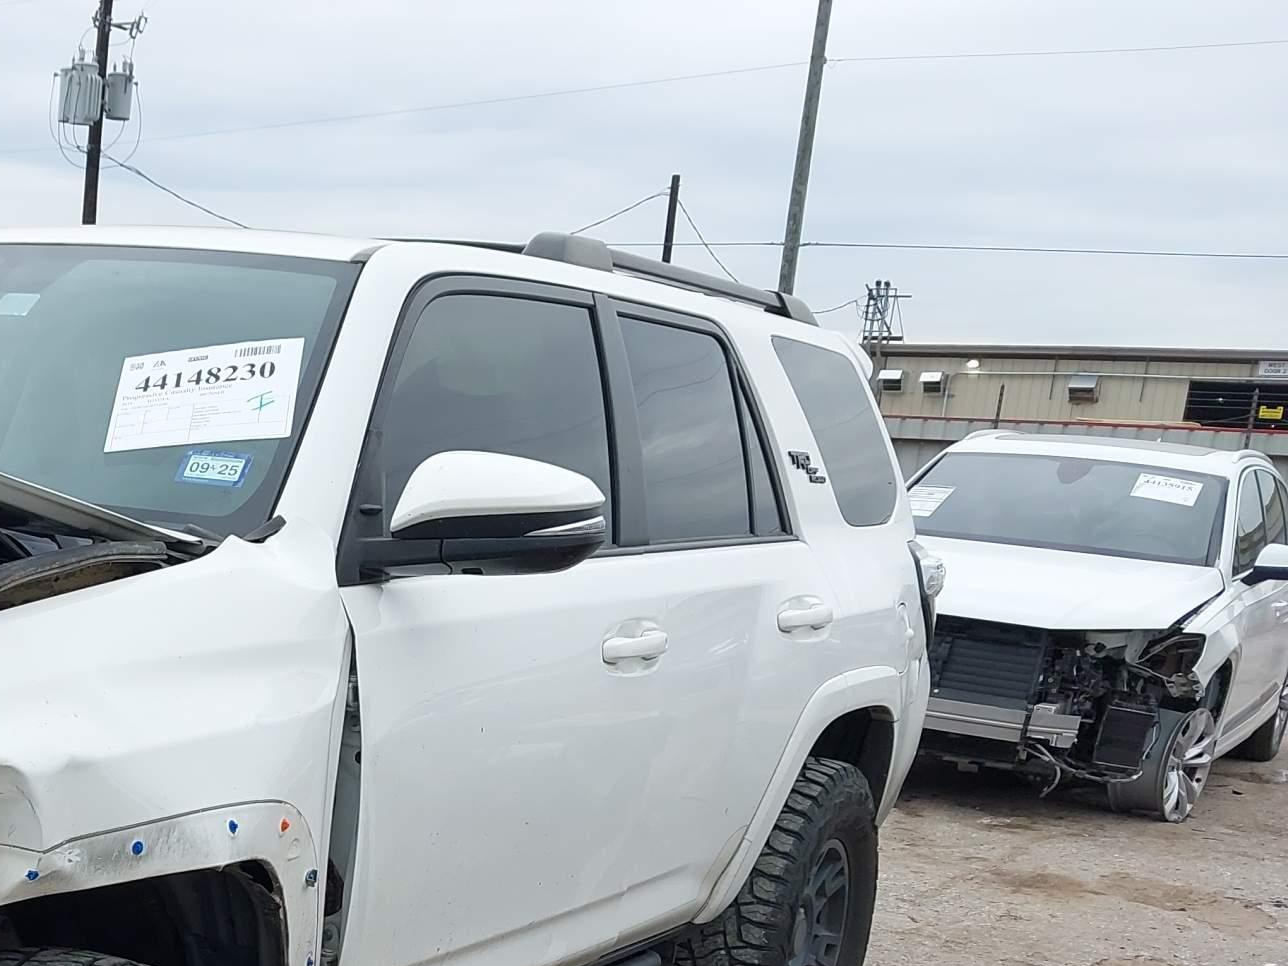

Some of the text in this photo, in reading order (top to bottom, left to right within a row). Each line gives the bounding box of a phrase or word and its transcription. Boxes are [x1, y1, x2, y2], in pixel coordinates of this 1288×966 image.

[135, 361, 276, 393] 44148230
[189, 461, 239, 477] 09 25
